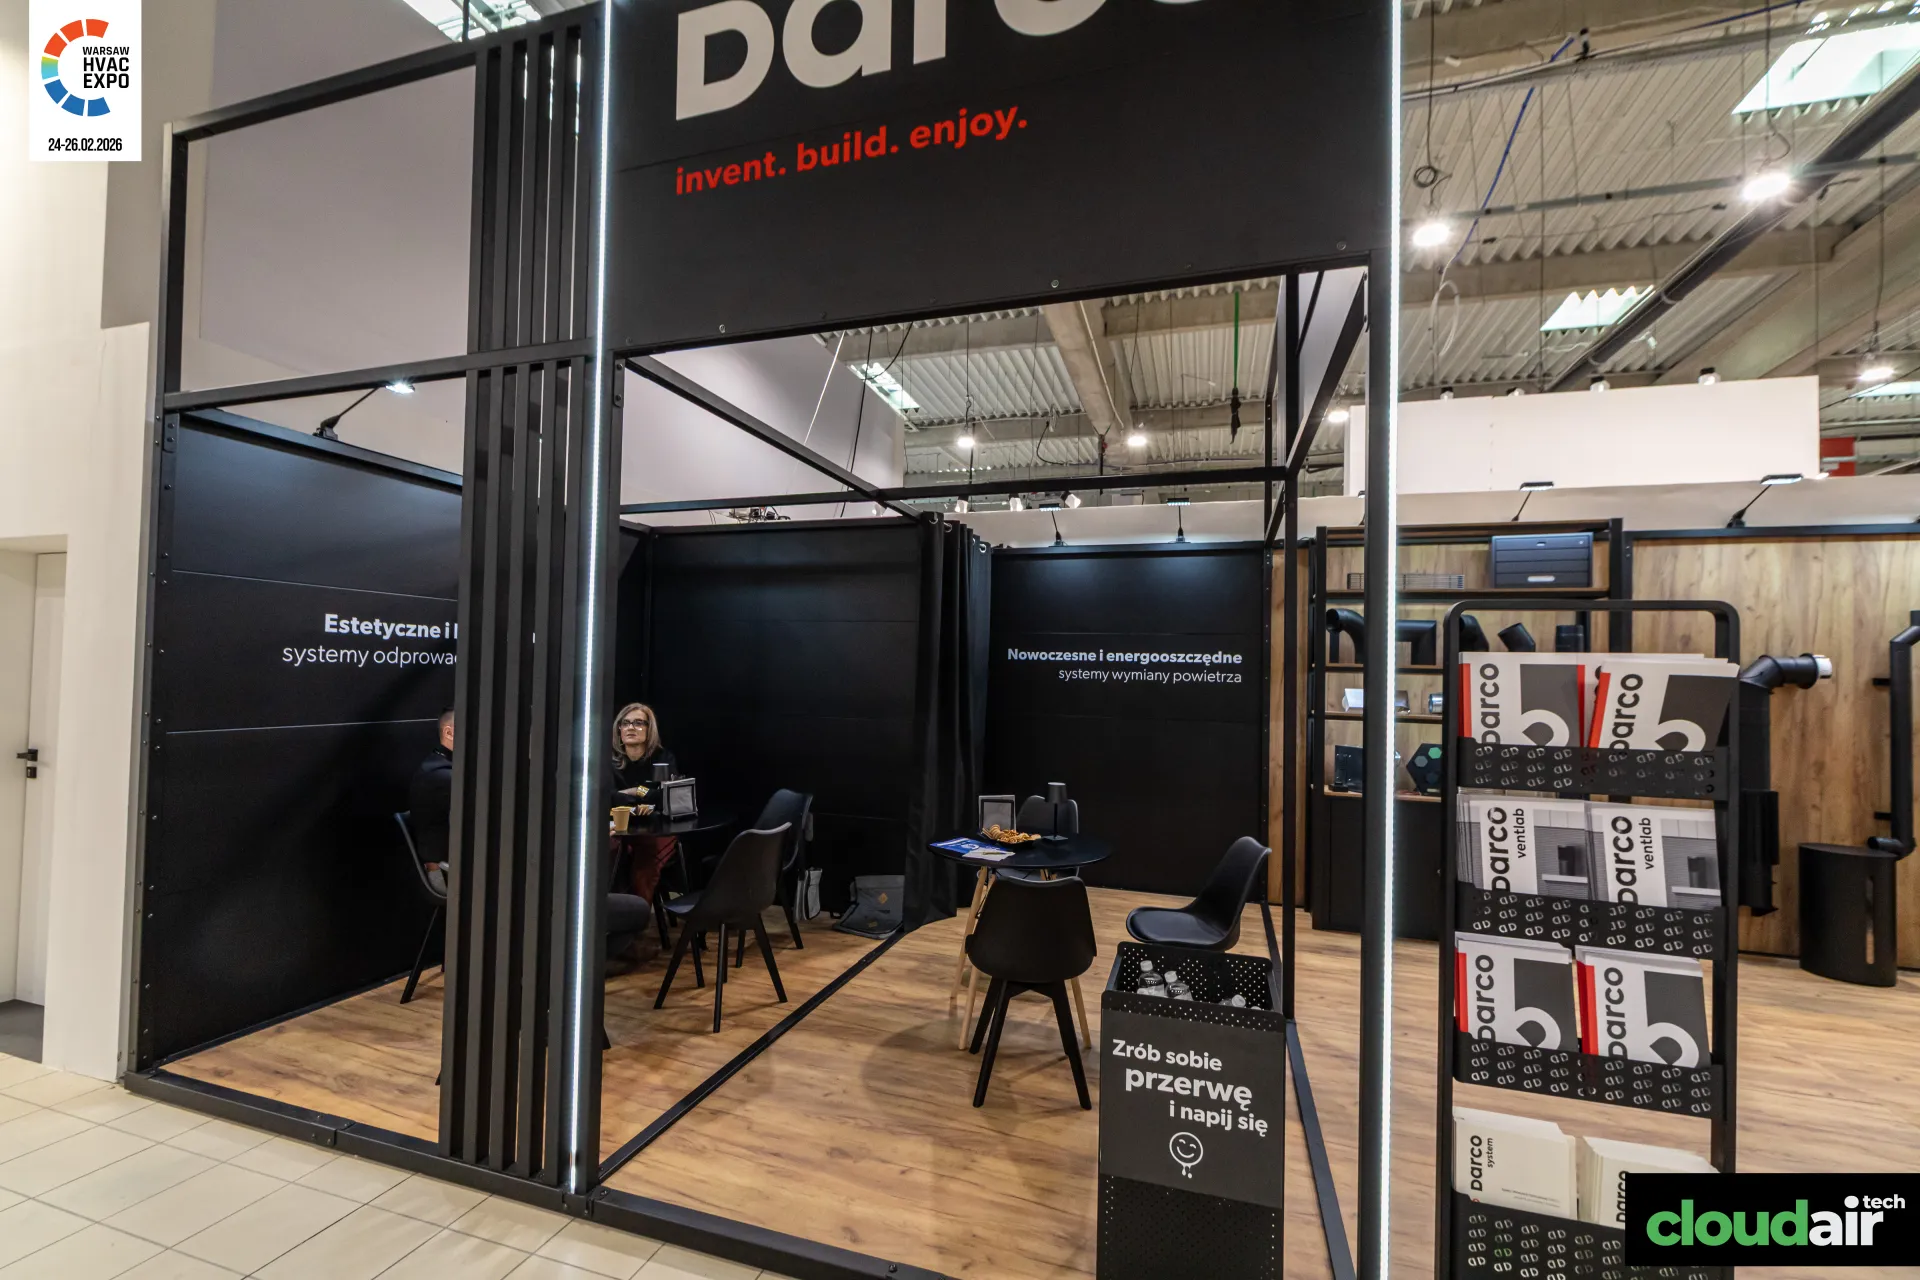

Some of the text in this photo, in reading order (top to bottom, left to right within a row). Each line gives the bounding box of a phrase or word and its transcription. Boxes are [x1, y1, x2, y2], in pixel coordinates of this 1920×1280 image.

[676, 105, 1028, 195] invent. build. enjoy.
[324, 613, 441, 640] Estetyczne
[444, 621, 450, 640] i
[282, 645, 458, 668] systemy odprowa
[1007, 648, 1243, 666] Nowoczesne i energooszczędne
[1058, 667, 1242, 684] systemy wymiany powietrza
[1512, 808, 1527, 859] ventlab
[1638, 817, 1655, 870] ventlab
[1112, 1038, 1223, 1072] Zrób sobie
[1125, 1067, 1253, 1111] przerwę
[1169, 1100, 1269, 1137] i napij się
[1485, 1137, 1495, 1168] system
